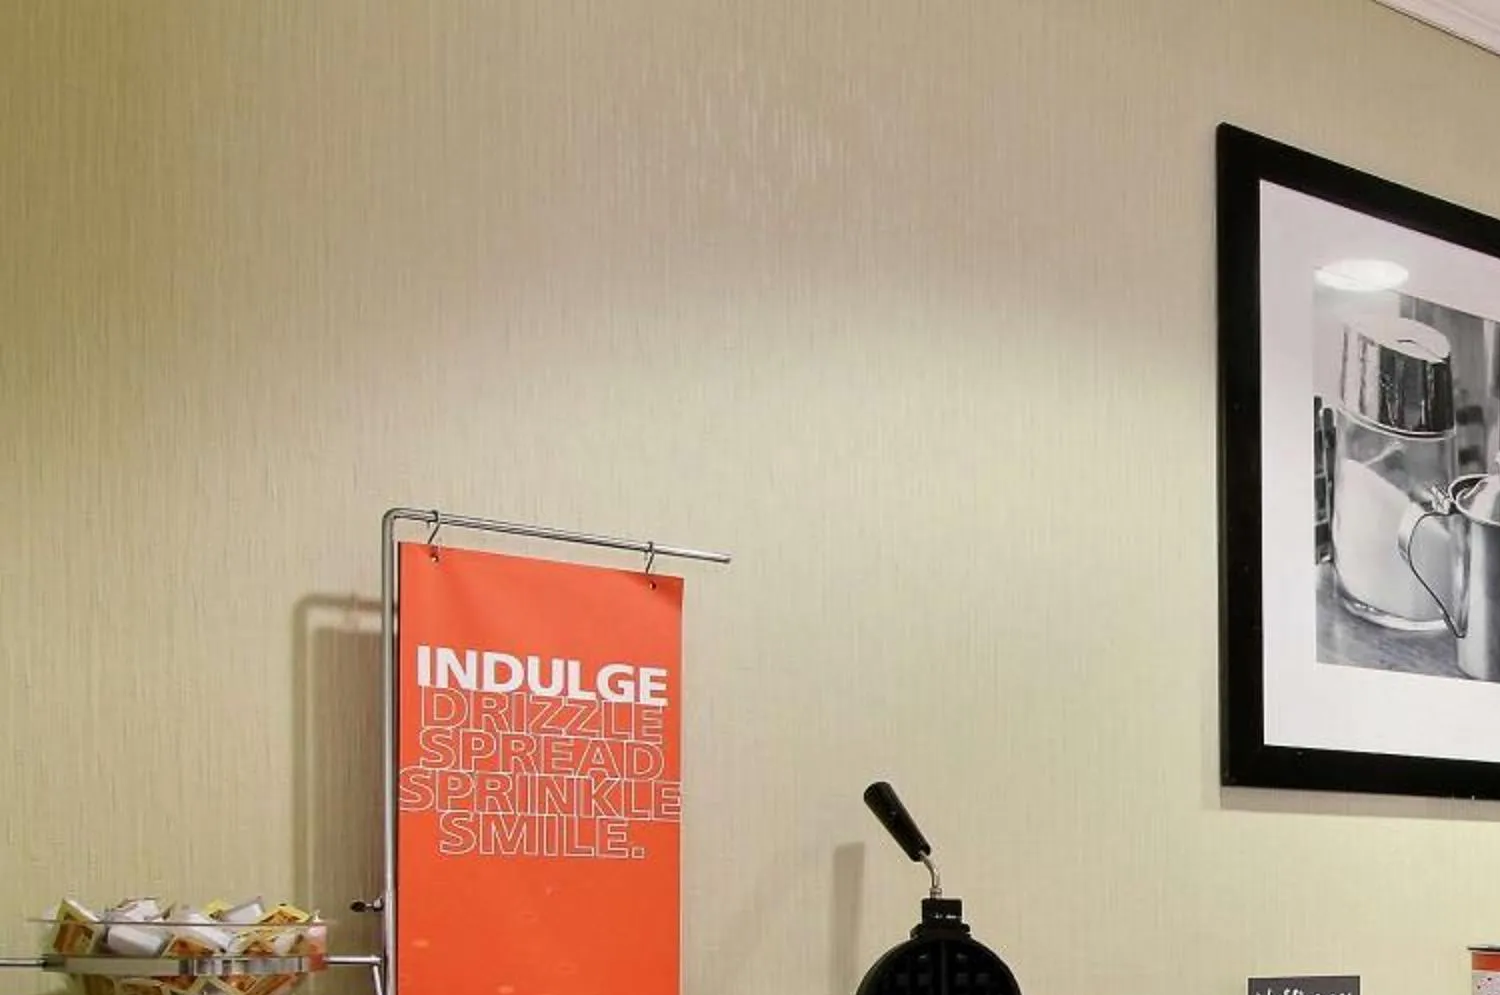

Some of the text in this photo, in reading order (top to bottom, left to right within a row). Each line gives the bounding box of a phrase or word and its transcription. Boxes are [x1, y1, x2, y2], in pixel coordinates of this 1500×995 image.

[417, 645, 669, 707] INDULGE
[420, 685, 664, 745] DRIZZLE
[419, 726, 665, 782] SPREAD
[399, 766, 682, 822] SPRINKLE
[439, 811, 645, 859] SMILE.
